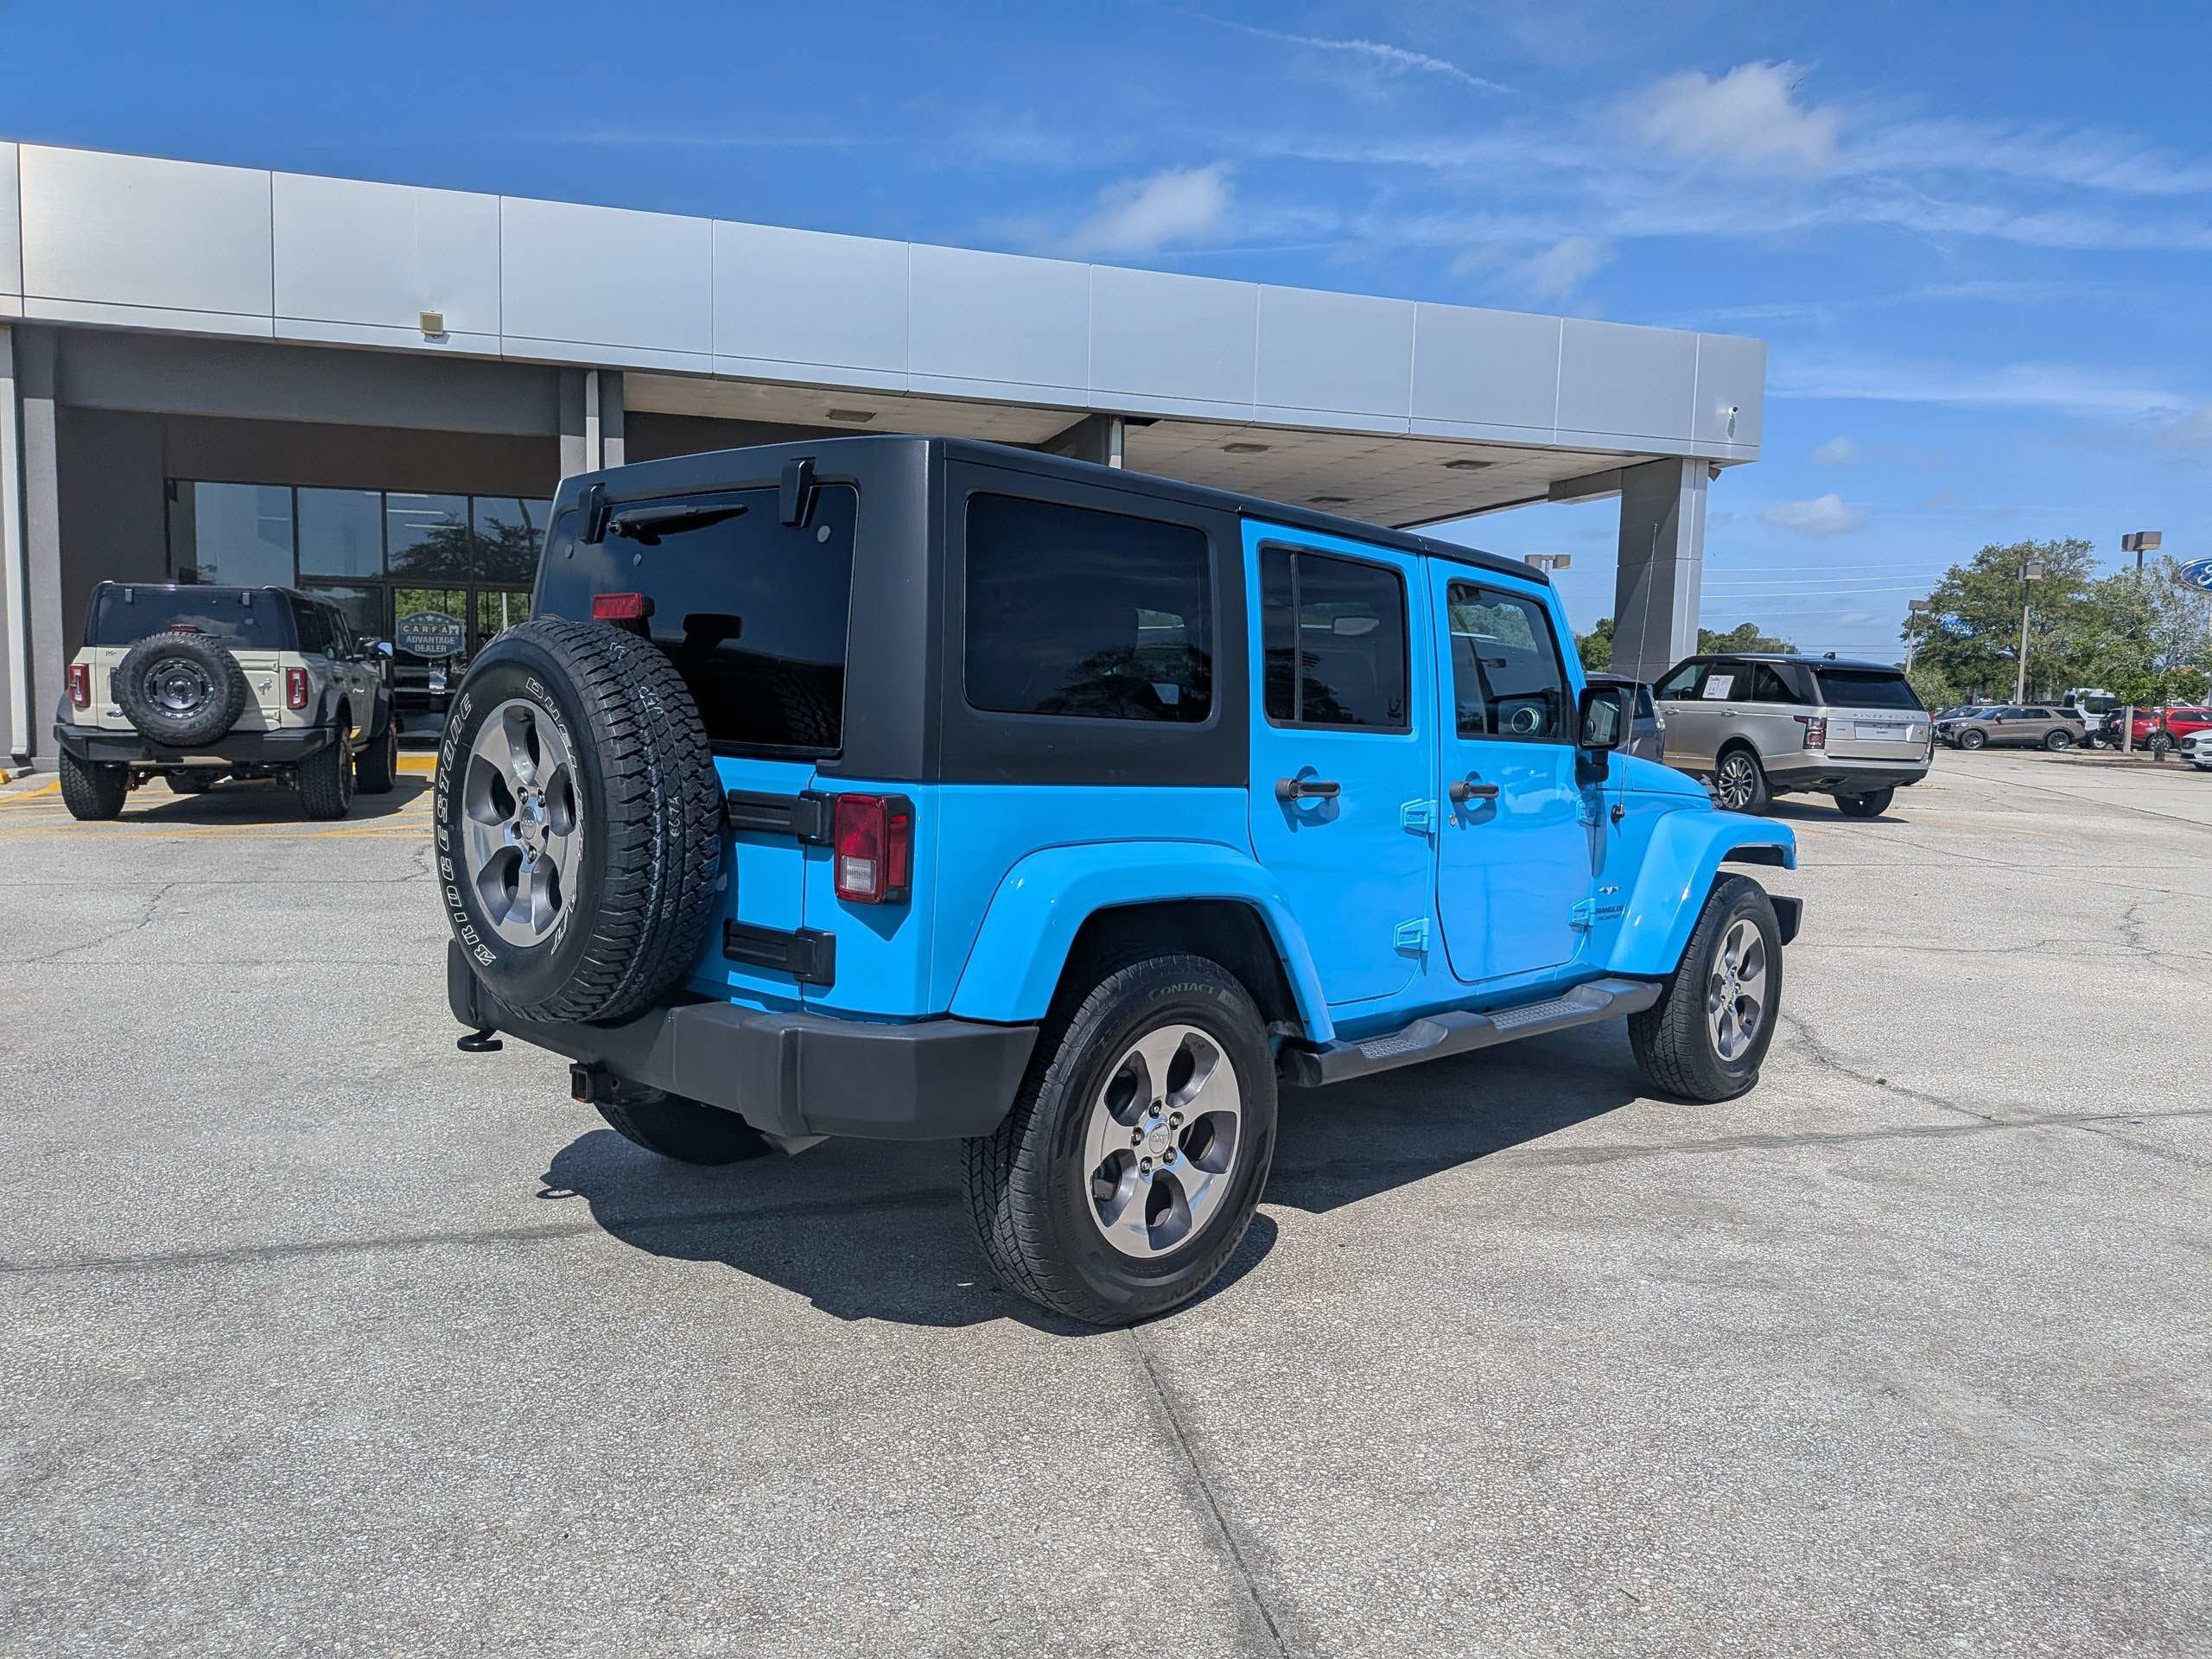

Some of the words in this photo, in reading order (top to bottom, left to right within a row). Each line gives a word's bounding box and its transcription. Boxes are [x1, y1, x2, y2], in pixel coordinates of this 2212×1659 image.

[403, 625, 457, 635] CARFAX
[406, 636, 454, 645] ADVANTAGE
[436, 693, 497, 967] BRIDGESTONE
[1148, 982, 1216, 1001] CONTACT
